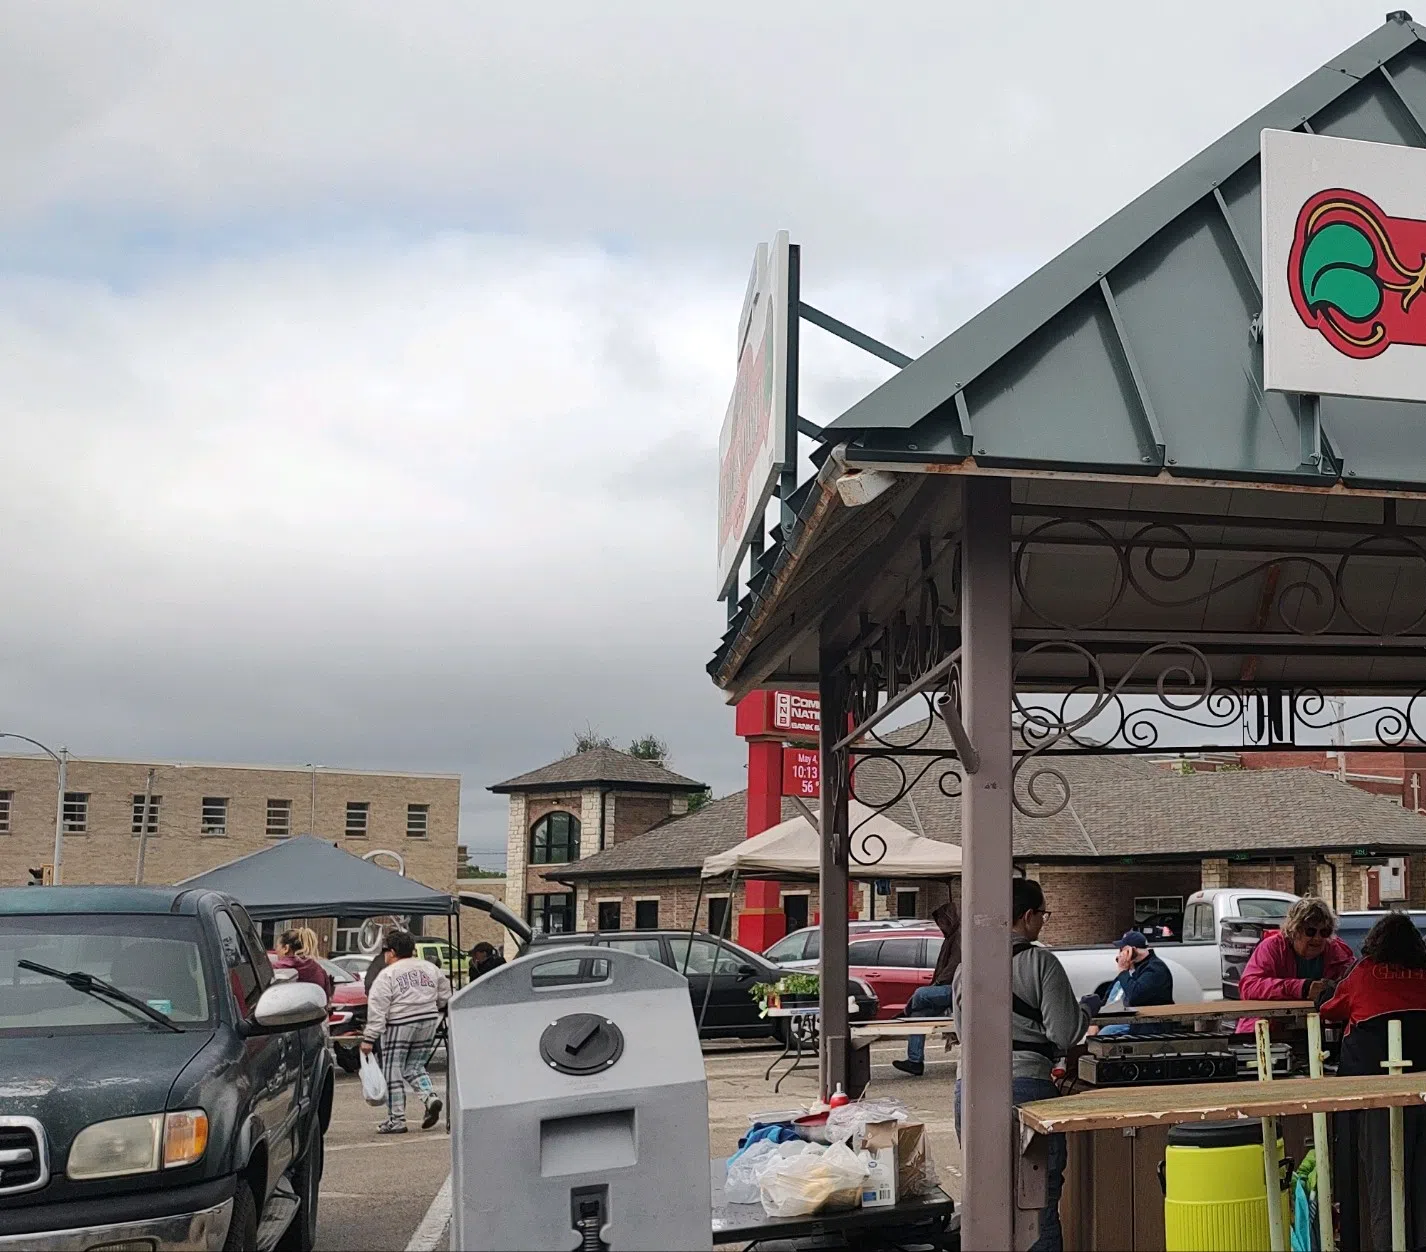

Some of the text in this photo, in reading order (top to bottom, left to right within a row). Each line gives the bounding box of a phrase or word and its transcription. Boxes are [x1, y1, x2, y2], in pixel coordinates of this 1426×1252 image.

[791, 722, 814, 731] BANK
[798, 753, 811, 765] May
[792, 765, 818, 779] 10:13
[801, 781, 813, 793] 56
[395, 969, 436, 993] USA
